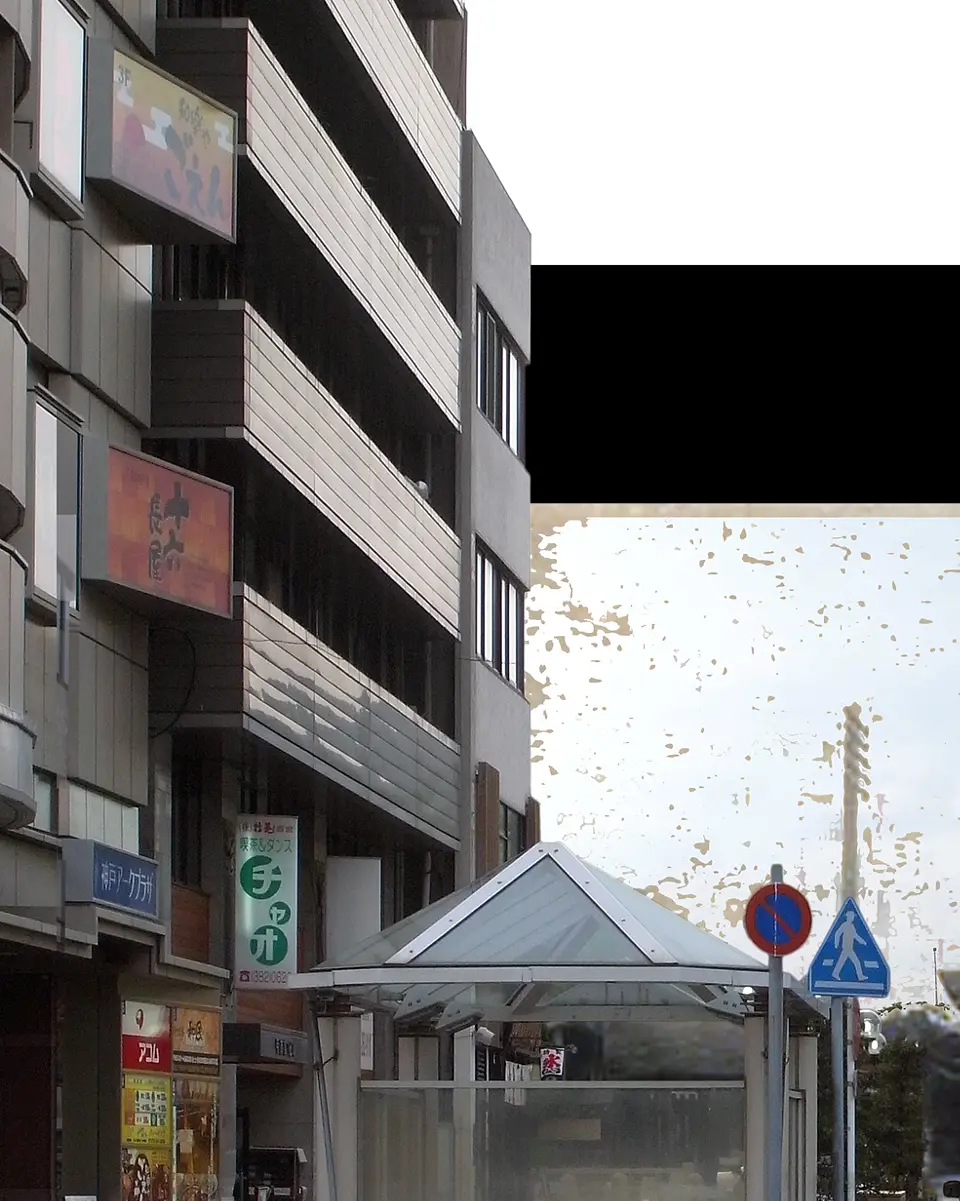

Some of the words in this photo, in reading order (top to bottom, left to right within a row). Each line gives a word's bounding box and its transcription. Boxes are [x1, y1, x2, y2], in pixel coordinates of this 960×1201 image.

[101, 860, 154, 904] 神戸アークプラザ
[240, 855, 291, 965] チャオ
[138, 1042, 160, 1064] アコム
[543, 1053, 561, 1071] 氷
